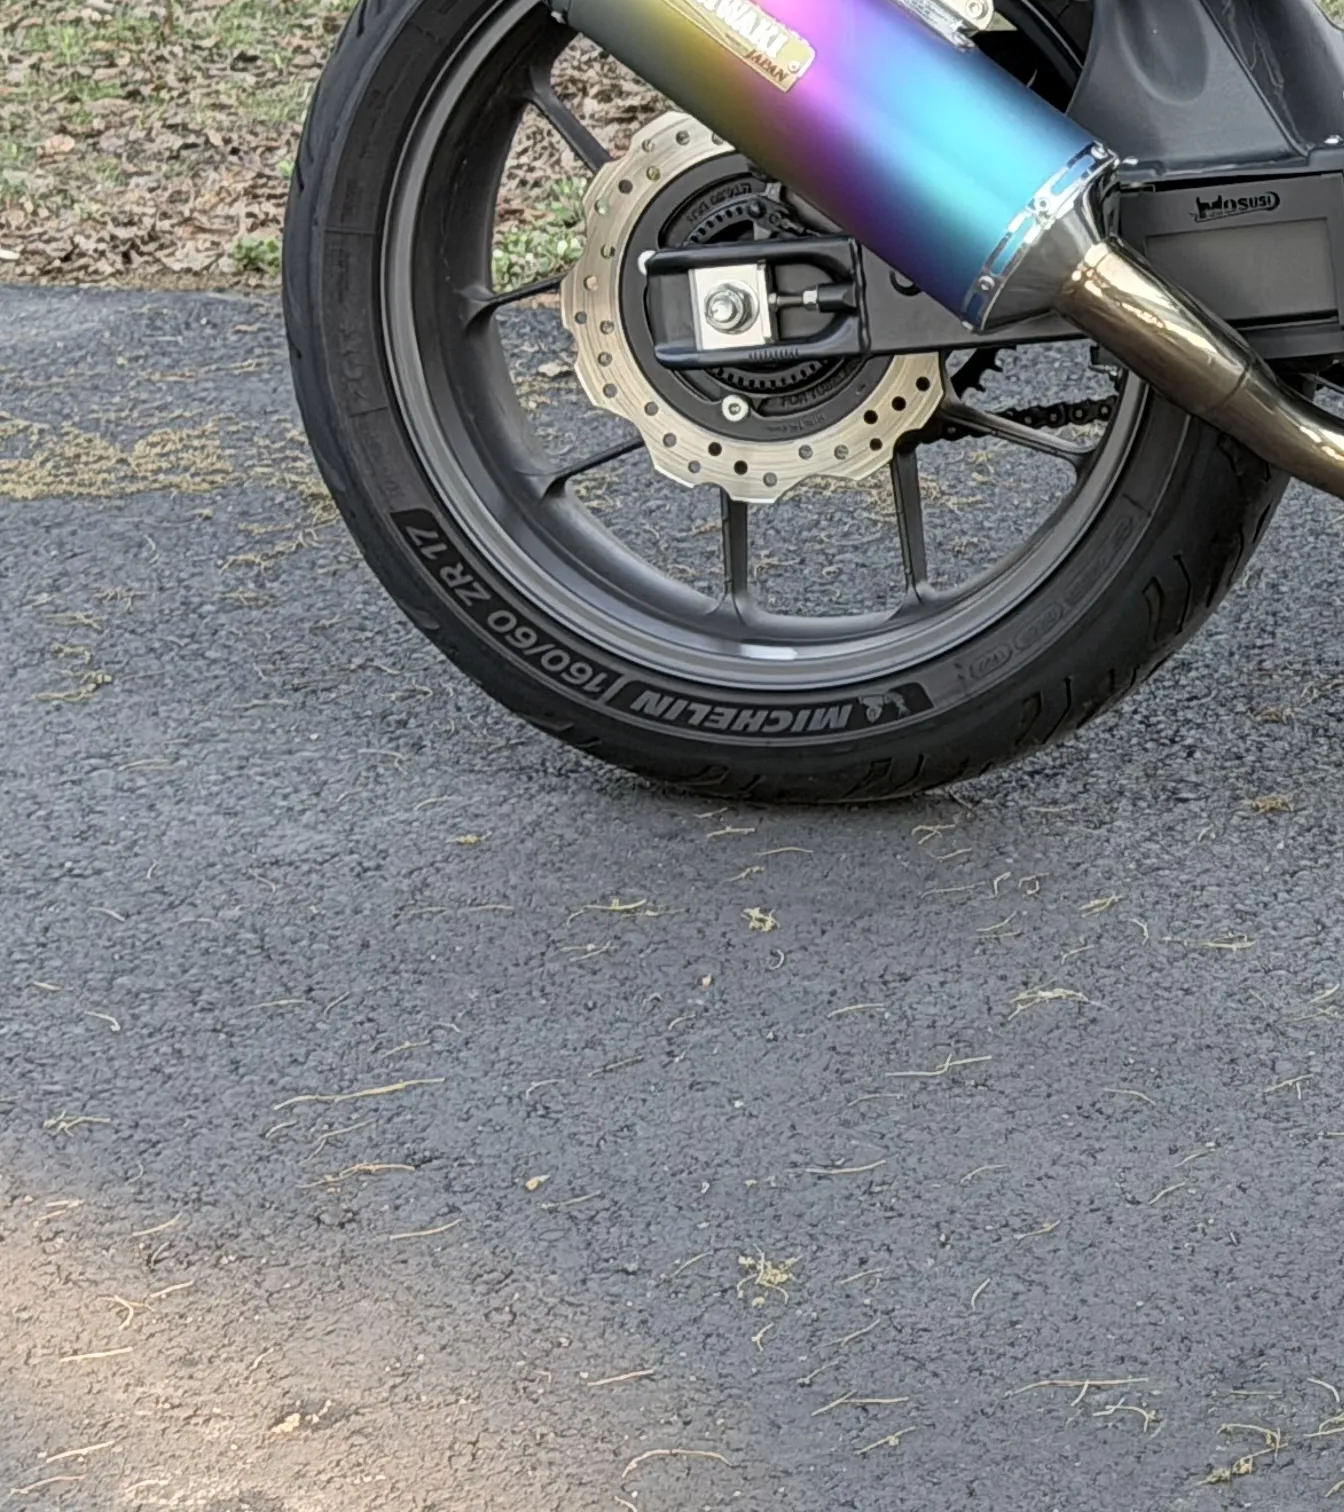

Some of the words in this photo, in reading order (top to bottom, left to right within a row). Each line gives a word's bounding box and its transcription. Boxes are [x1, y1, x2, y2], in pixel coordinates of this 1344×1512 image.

[747, 49, 790, 82] JAPAN
[405, 525, 448, 561] 17
[438, 561, 493, 608] ZR
[486, 609, 608, 694] 160/60
[629, 690, 853, 733] MICHELIN
